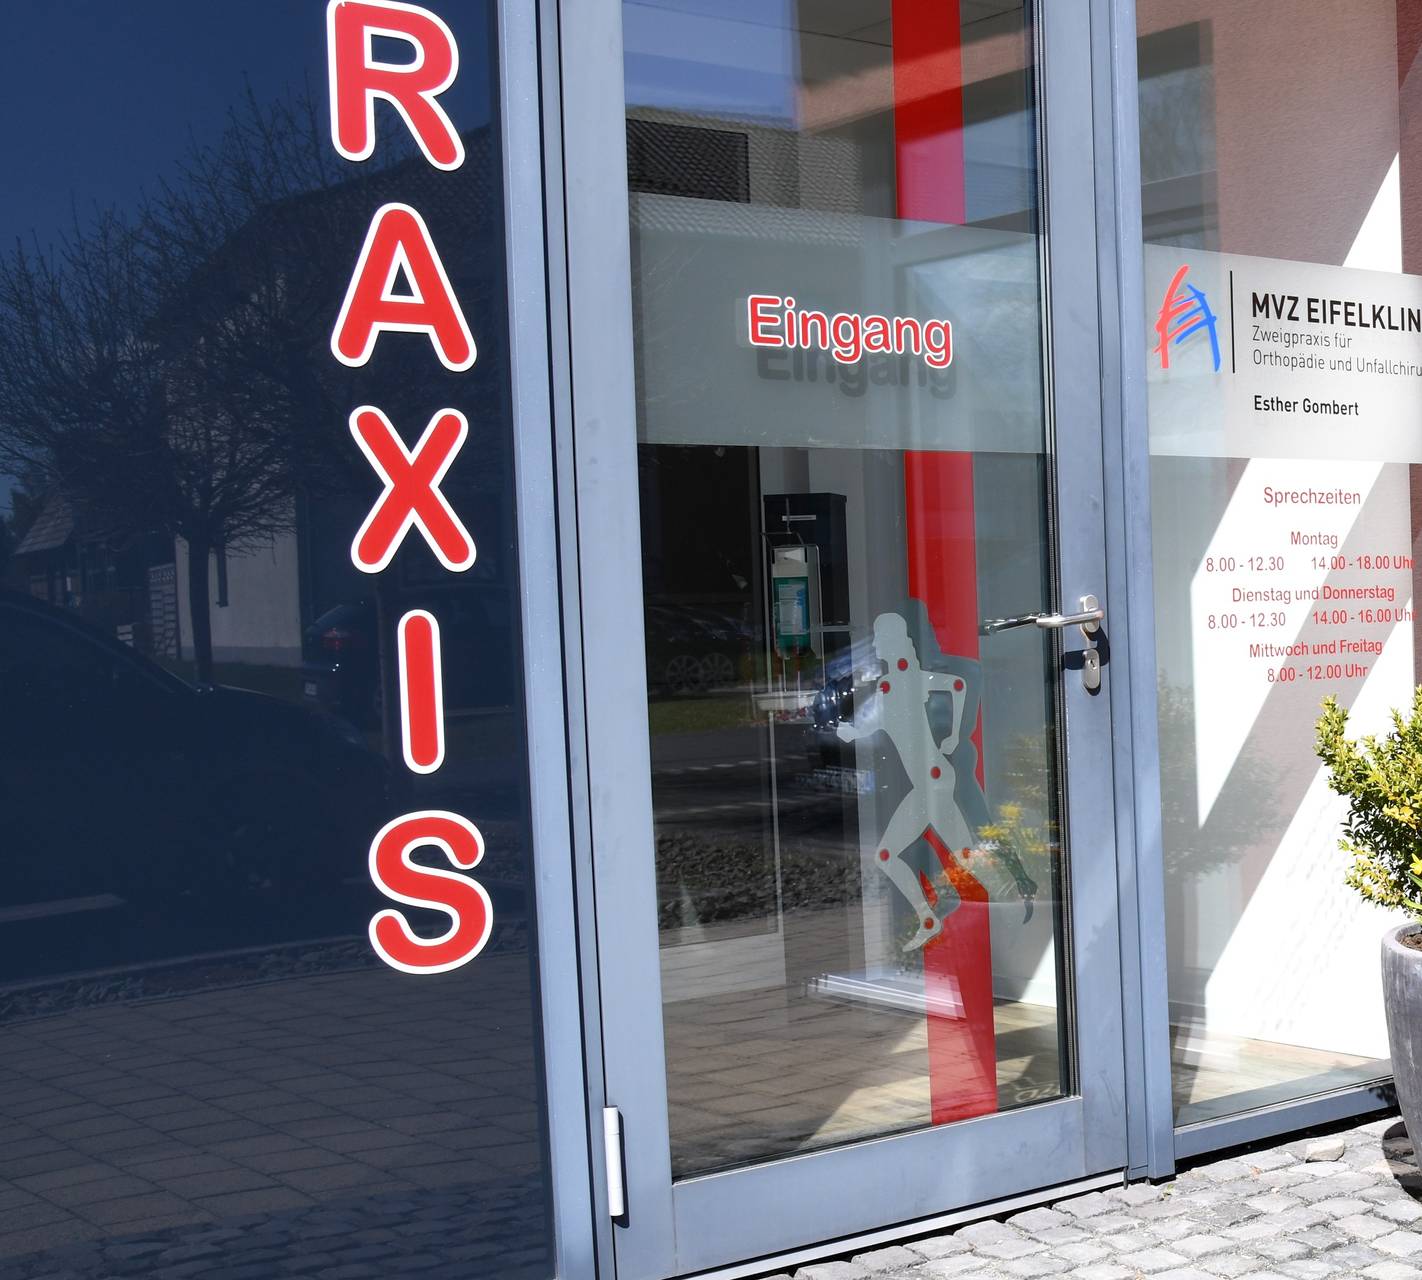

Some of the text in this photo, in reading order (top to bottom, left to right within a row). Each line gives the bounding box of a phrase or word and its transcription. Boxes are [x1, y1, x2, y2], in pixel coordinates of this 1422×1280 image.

[1252, 291, 1300, 322] MVZ
[748, 294, 953, 369] Eingang
[1252, 325, 1352, 349] Zweigpraxis für
[1253, 349, 1325, 371] Orthopädie
[1329, 356, 1352, 371] und
[1254, 394, 1359, 416] Esther Gombert
[1263, 486, 1361, 507] Sprechzeiten
[1290, 531, 1338, 549] Montag
[1206, 557, 1236, 572] 8.00
[1248, 556, 1285, 571] 12.30
[1311, 555, 1346, 570] 14.00
[1356, 555, 1390, 570] 18.00
[1393, 555, 1416, 569] Uhr
[1232, 585, 1395, 605] Dienstag und Donnerstag
[1208, 614, 1238, 629] 8.00
[1250, 612, 1286, 628] 12.30
[1312, 610, 1347, 625] 14.00
[1358, 608, 1391, 623] 16.00
[1249, 639, 1383, 658] Mittwoch und Freitag
[1267, 667, 1296, 682] 8.00
[1307, 665, 1341, 680] 12.00
[1345, 664, 1368, 678] Uhr
